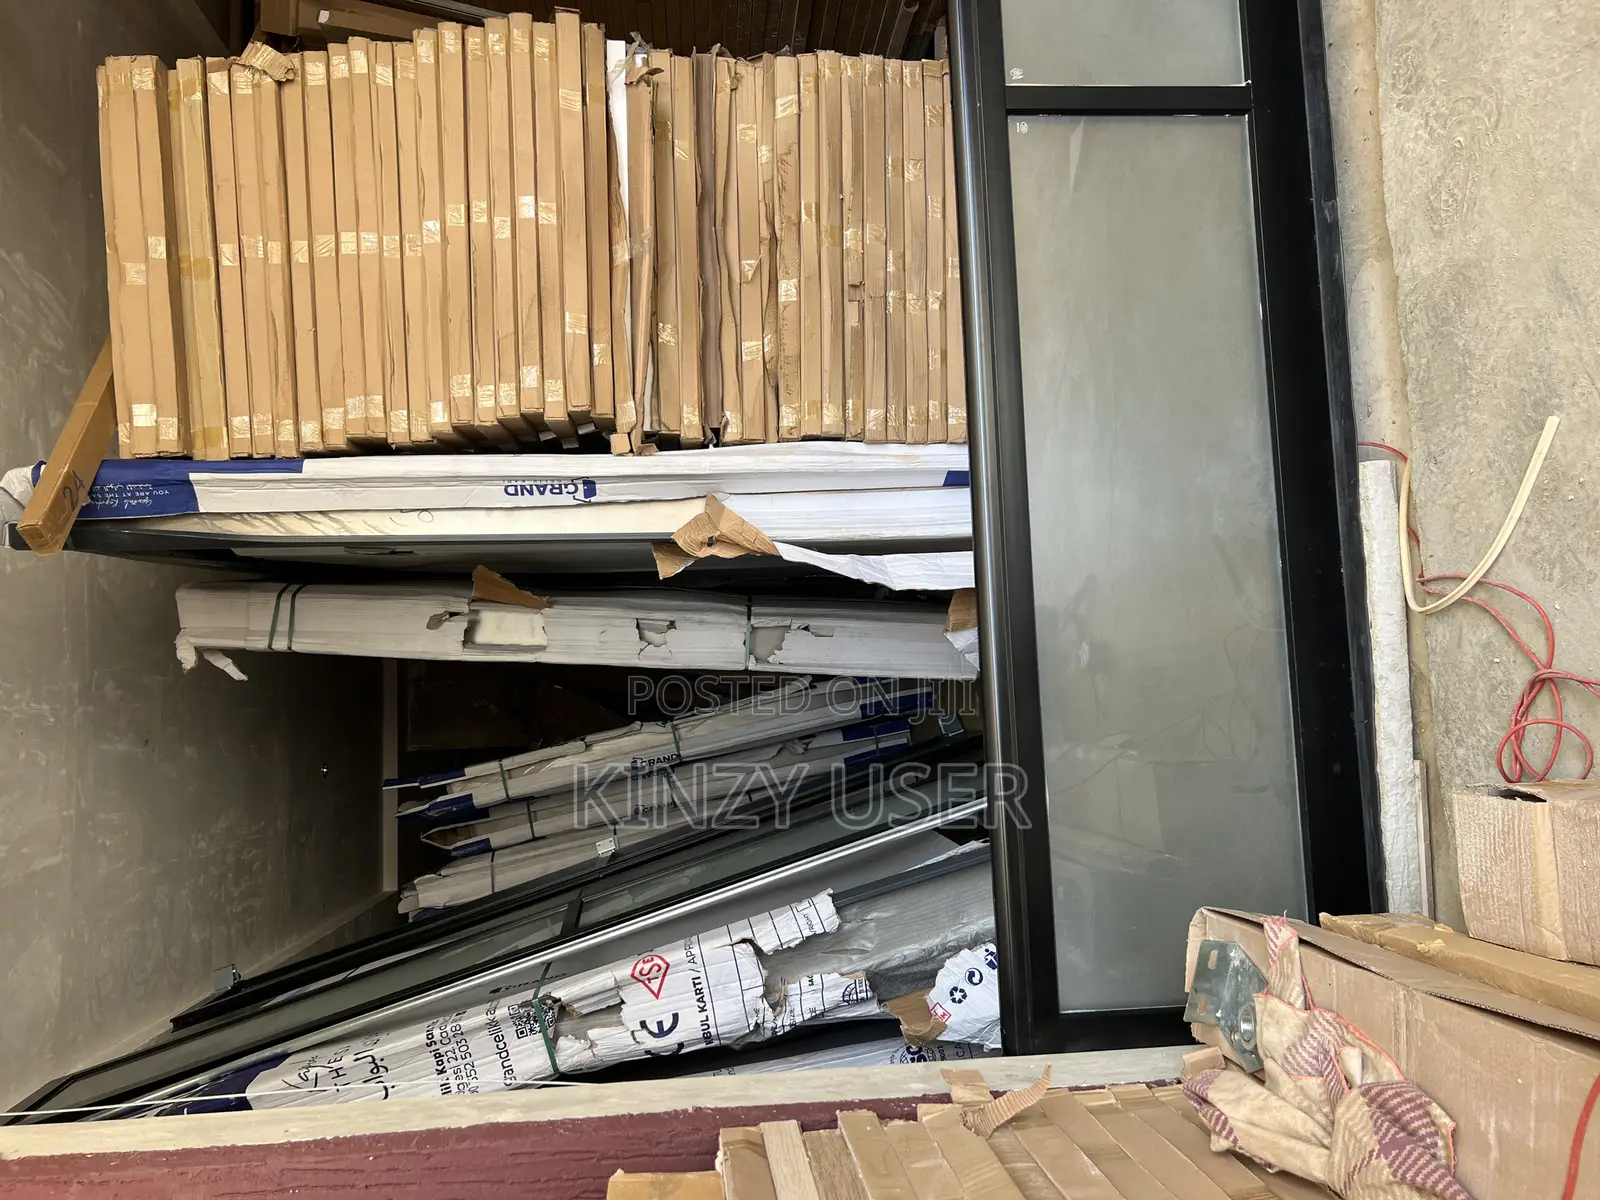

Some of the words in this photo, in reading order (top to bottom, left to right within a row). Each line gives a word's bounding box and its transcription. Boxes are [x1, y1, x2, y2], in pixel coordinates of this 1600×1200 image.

[503, 482, 579, 497] GRAND
[638, 956, 662, 984] TSE
[691, 976, 708, 1014] KARTI
[450, 1023, 464, 1038] 28
[455, 1038, 471, 1060] 503
